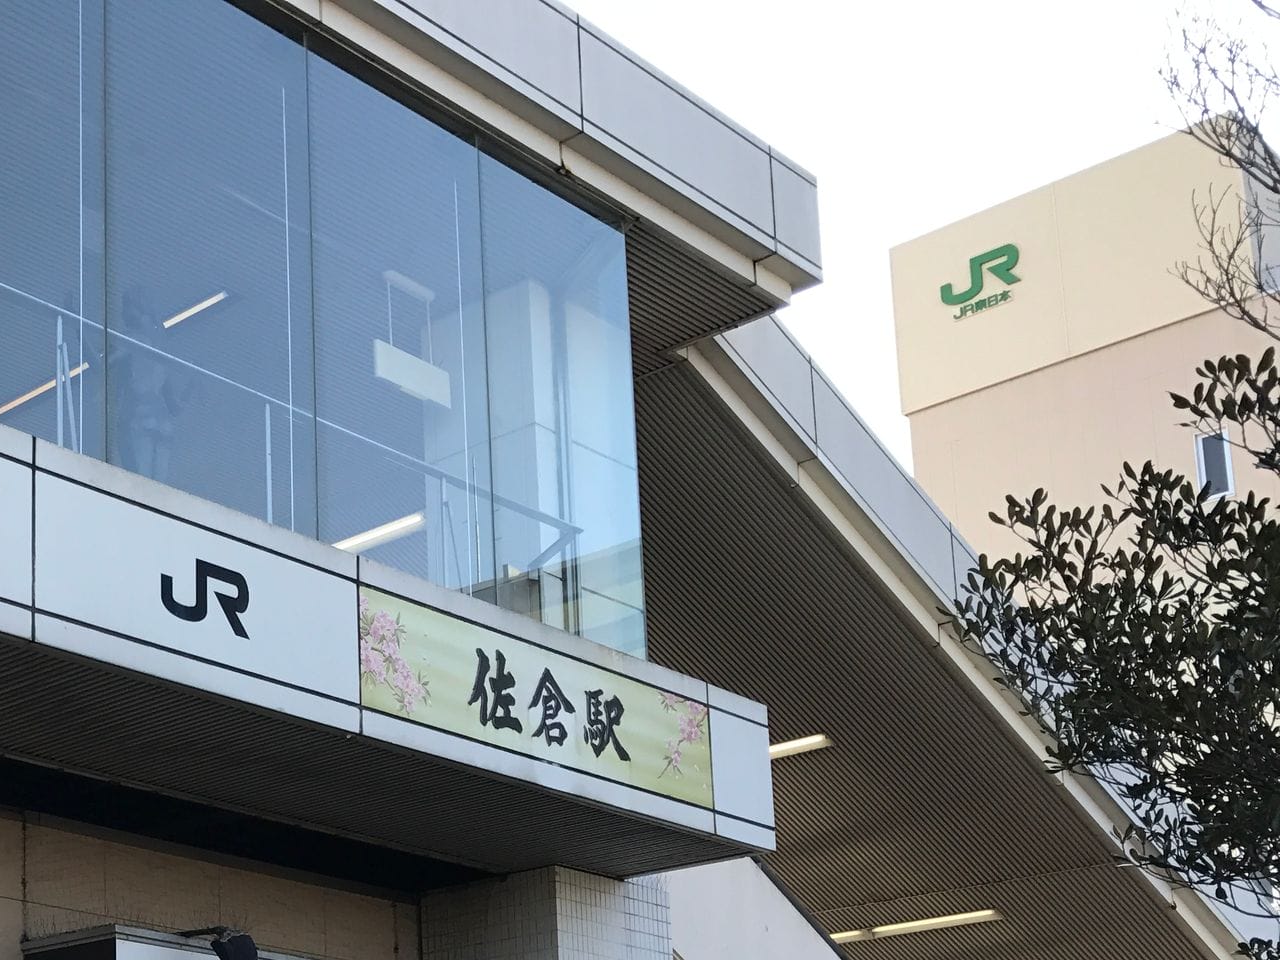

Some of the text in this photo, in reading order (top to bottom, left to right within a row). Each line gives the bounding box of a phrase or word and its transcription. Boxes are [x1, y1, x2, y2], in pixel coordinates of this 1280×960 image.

[940, 243, 1022, 306] JR
[160, 558, 250, 640] JR
[467, 648, 631, 763] 佐倉駅
